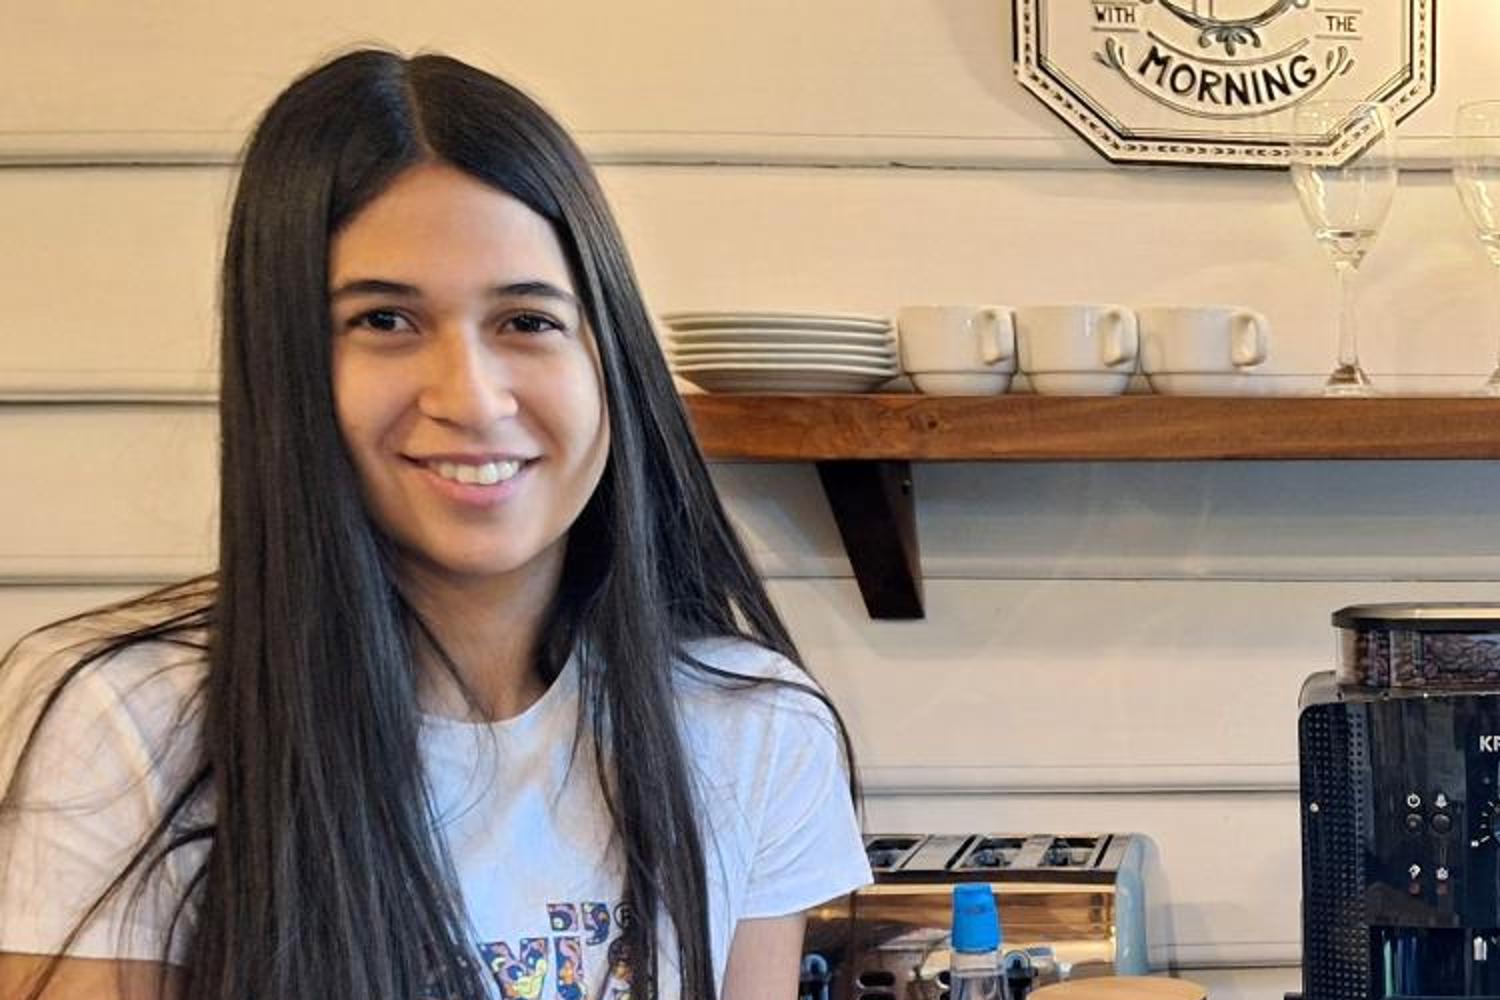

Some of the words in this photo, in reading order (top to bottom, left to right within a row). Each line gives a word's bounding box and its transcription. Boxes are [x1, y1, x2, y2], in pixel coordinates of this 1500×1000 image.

[1094, 6, 1136, 24] WITH
[1326, 15, 1358, 33] THE
[1138, 45, 1317, 106] MORNING
